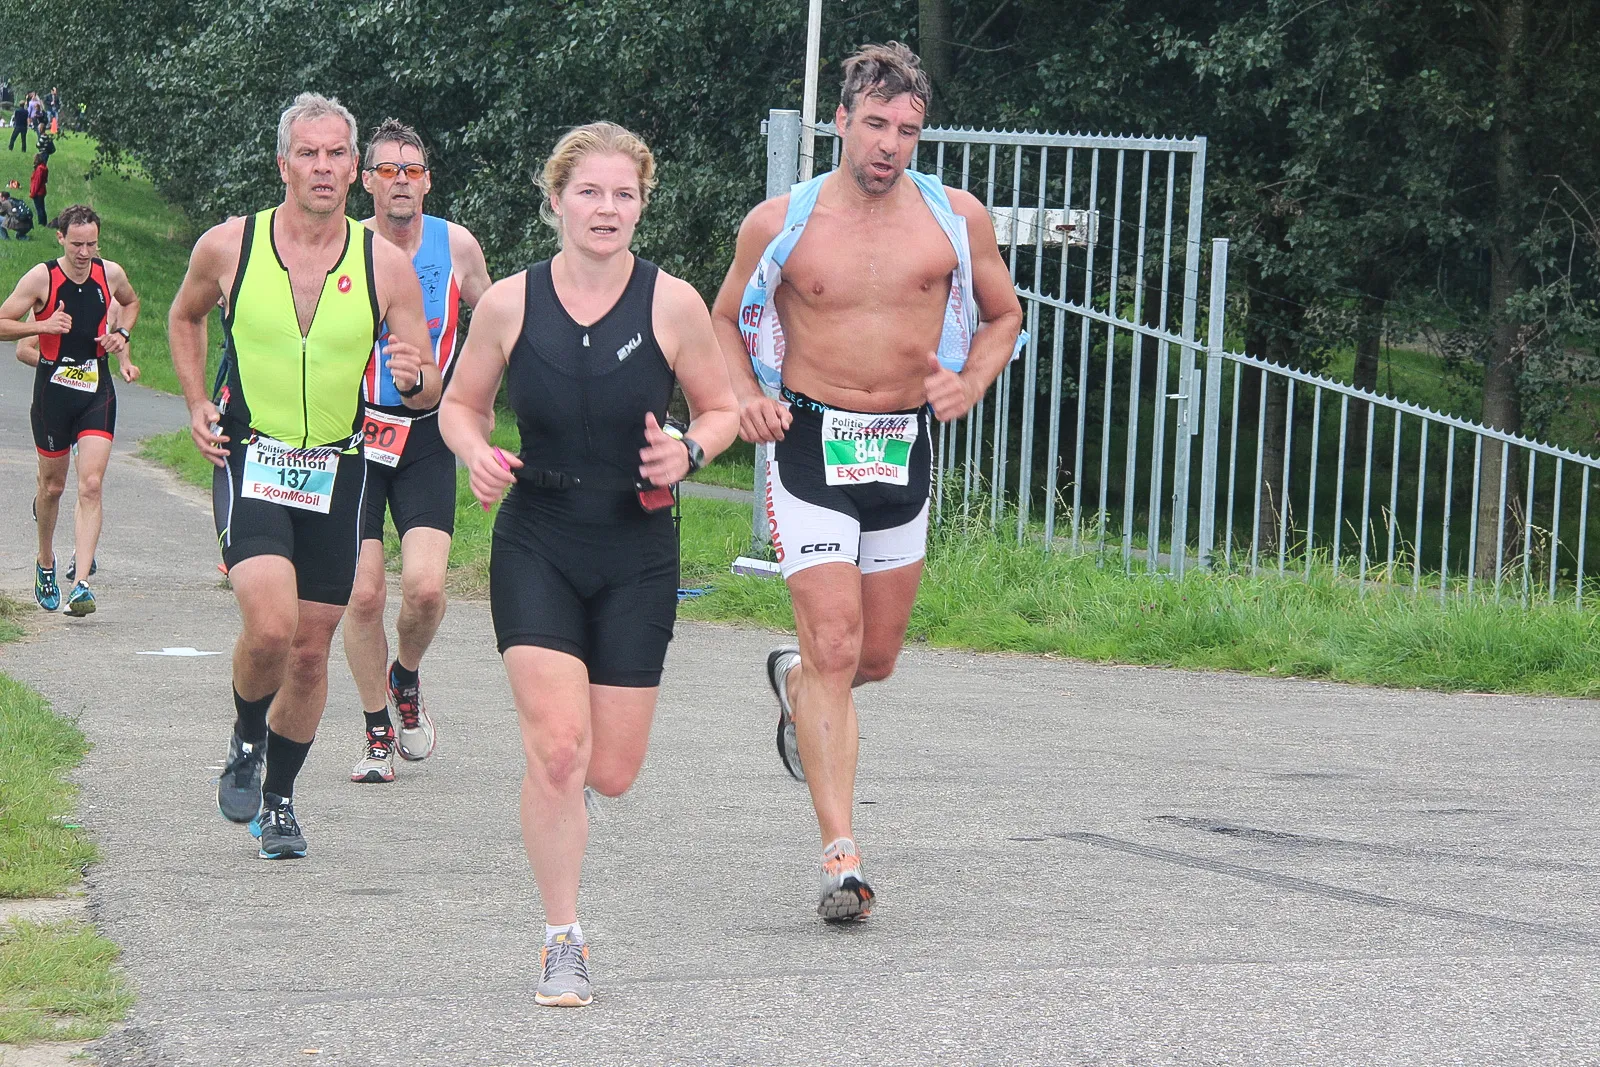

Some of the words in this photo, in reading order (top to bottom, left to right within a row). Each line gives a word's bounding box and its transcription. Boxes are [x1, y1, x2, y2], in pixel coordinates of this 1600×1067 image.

[65, 366, 85, 380] 726
[832, 417, 863, 428] Politie
[257, 442, 285, 454] Politie
[256, 451, 327, 470] Triathlon
[277, 468, 311, 490] 137
[253, 483, 320, 506] ExxonMobil
